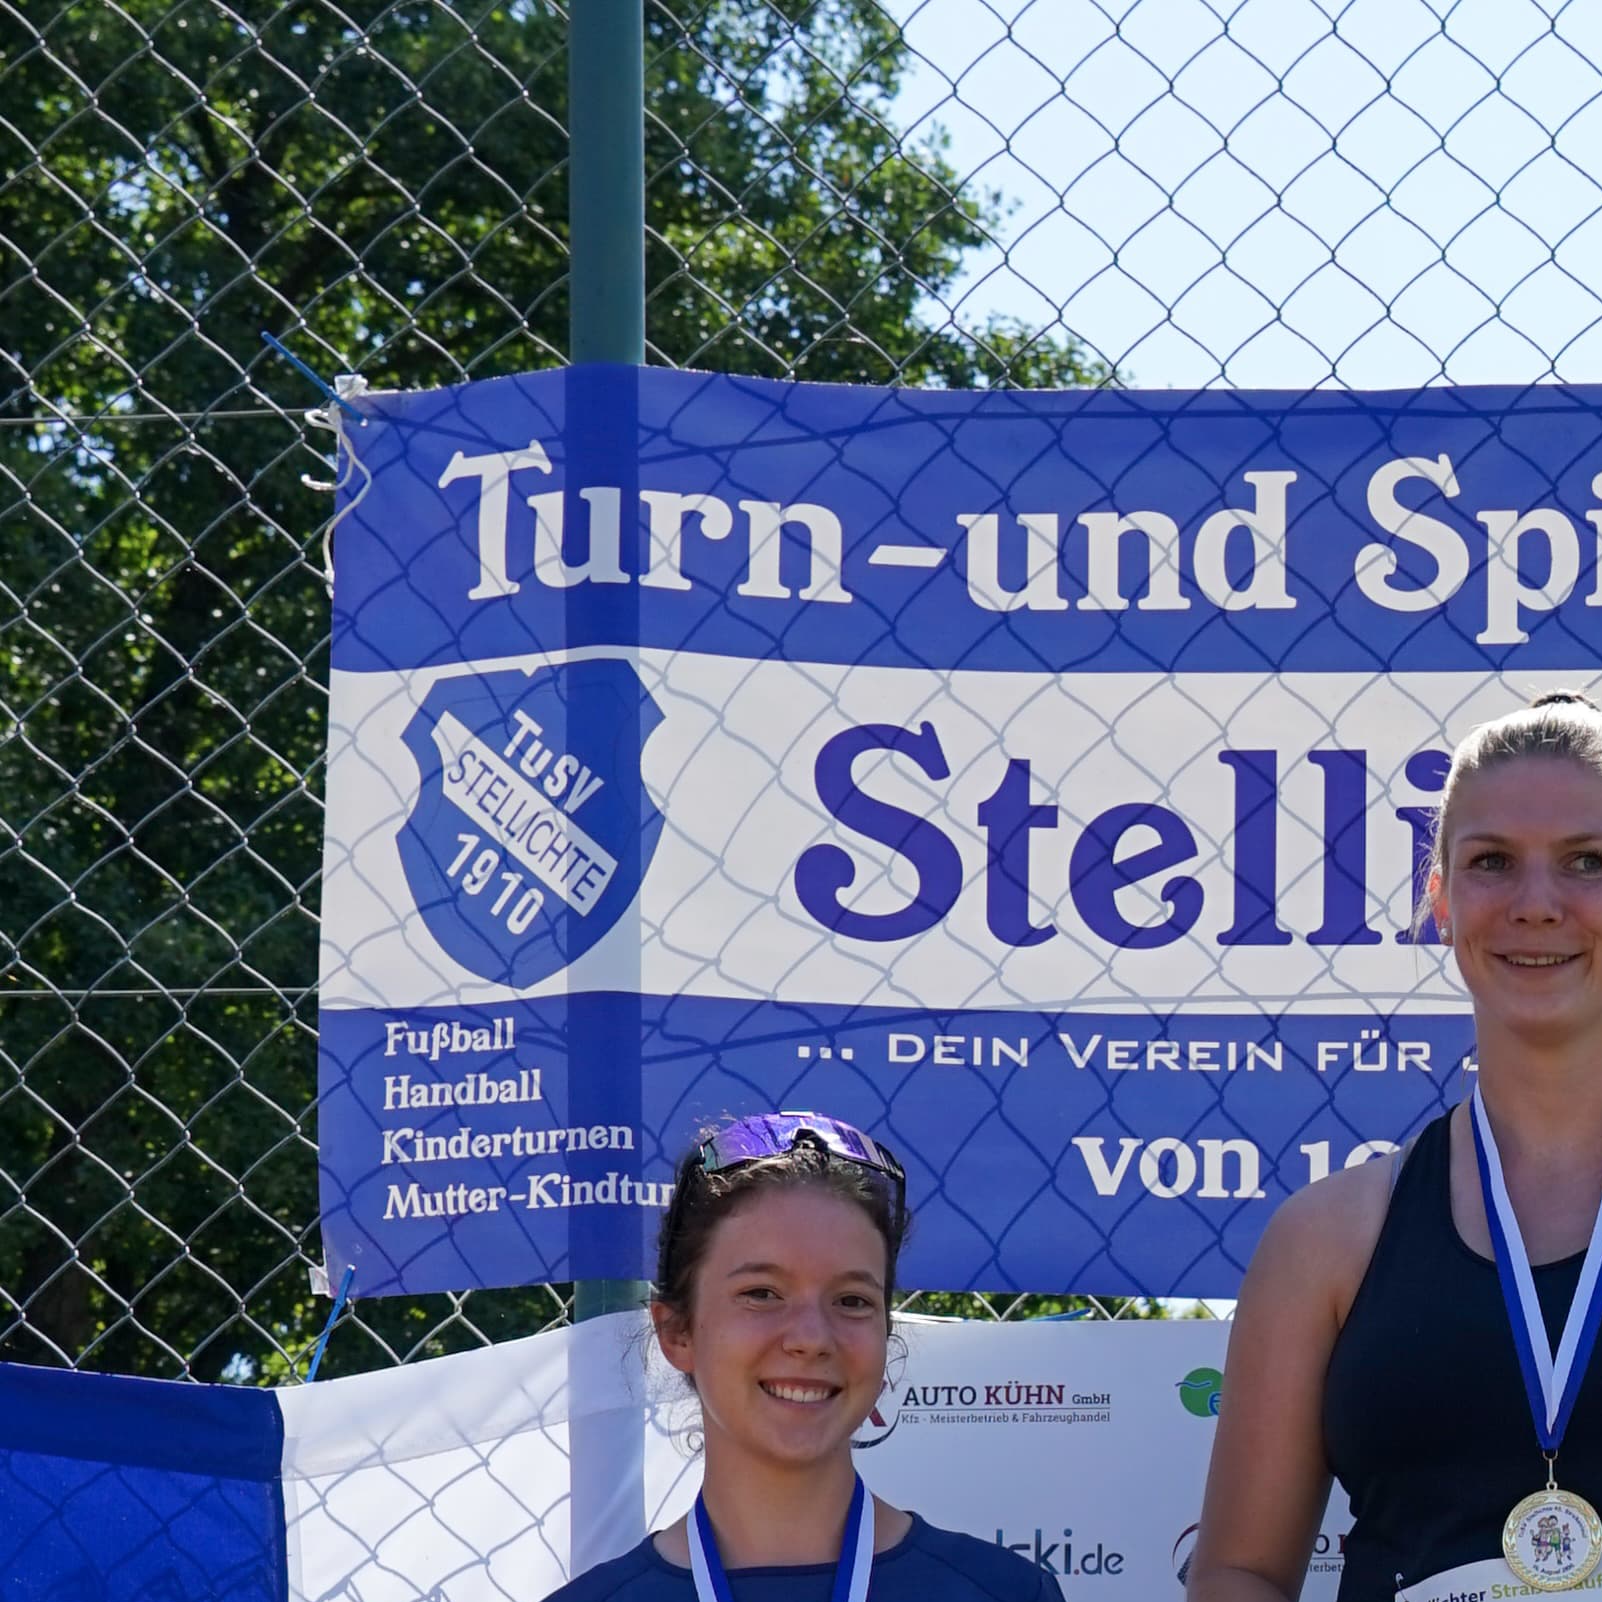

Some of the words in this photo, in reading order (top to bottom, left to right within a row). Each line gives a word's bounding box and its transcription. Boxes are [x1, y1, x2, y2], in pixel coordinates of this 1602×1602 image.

[438, 438, 1298, 611] Turn-und
[502, 708, 605, 817] TuSV
[447, 750, 607, 902] STELLICHTE
[446, 833, 545, 935] 1910
[384, 1018, 515, 1062] Fußball
[888, 1033, 1030, 1069] DEIN
[1059, 1033, 1283, 1071] VEREIN
[1317, 1029, 1432, 1072] FÜR
[383, 1070, 541, 1110] Handball
[382, 1125, 634, 1164] Kinderturnen
[383, 1174, 675, 1219] Mutter-Kindtur
[902, 1386, 977, 1406] AUTO
[984, 1381, 1066, 1406] KÜHN
[1072, 1393, 1111, 1405] GmbH
[901, 1413, 920, 1424] Kfz
[929, 1412, 1009, 1424] Meisterbetrieb
[1022, 1411, 1111, 1425] Fahrzeughandel
